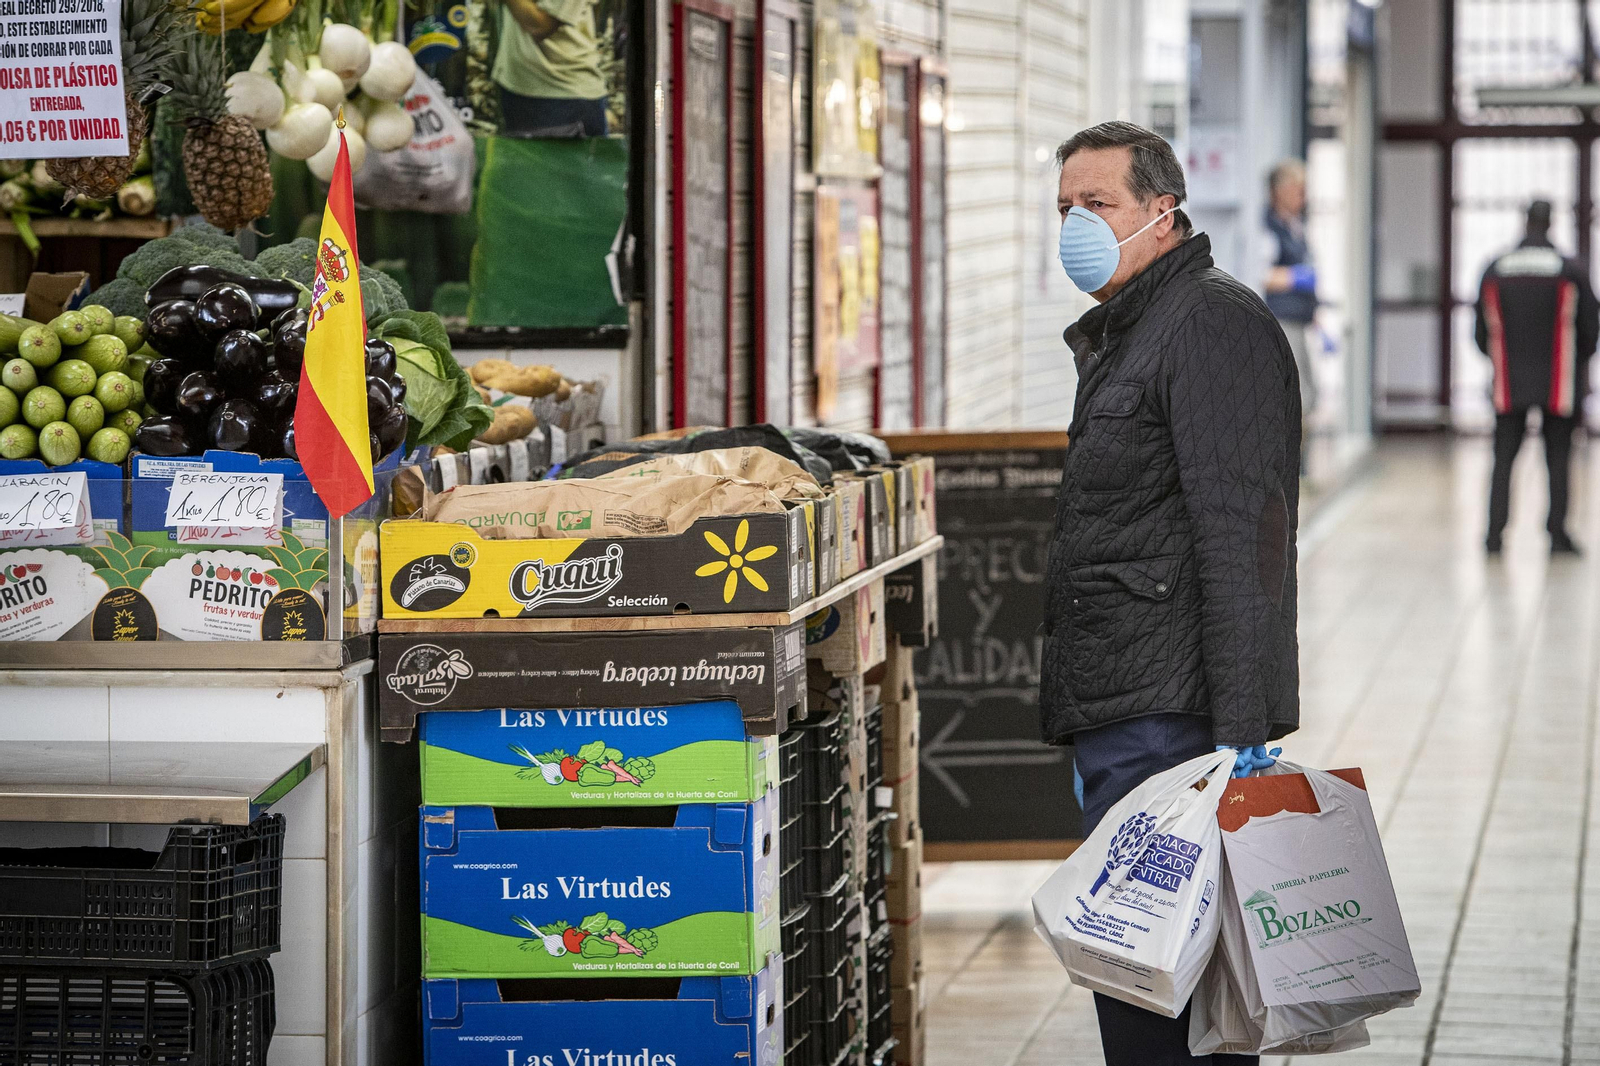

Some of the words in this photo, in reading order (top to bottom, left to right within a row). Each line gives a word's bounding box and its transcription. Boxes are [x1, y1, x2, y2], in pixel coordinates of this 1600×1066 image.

[18, 0, 56, 15] DECRETO
[59, 0, 105, 13] 293/2018,
[8, 21, 28, 36] ESTE
[30, 18, 107, 36] ESTABLECIMIENTO
[19, 43, 29, 57] DE
[31, 42, 68, 57] COBRAR
[69, 41, 87, 56] POR
[88, 40, 113, 55] CADA
[0, 67, 32, 90] OLSA
[35, 67, 51, 88] DE
[53, 62, 118, 88] PLÁSTICO
[30, 96, 85, 111] ENTREGADA,
[26, 120, 37, 142] €
[39, 119, 67, 141] POR
[69, 118, 124, 140] UNIDAD.
[0, 477, 71, 487] LABACIN
[180, 474, 269, 484] BERENJENA
[256, 508, 270, 521] €
[508, 543, 624, 611] Cuqui
[189, 578, 273, 610] PEDRITO
[607, 594, 668, 607] Selección
[13, 611, 18, 620] y
[20, 598, 54, 615] verduras
[203, 603, 228, 615] frutas
[230, 609, 235, 618] y
[602, 660, 677, 687] iceberg
[680, 656, 766, 687] lechuga
[413, 687, 447, 695] Natural
[499, 708, 546, 728] Las
[556, 708, 669, 728] Virtudes
[571, 791, 605, 800] Verduras
[613, 791, 652, 799] Hortalizas
[653, 791, 663, 799] de
[665, 791, 673, 799] la
[676, 791, 702, 799] Huerta
[704, 791, 714, 799] de
[717, 790, 738, 799] Conil
[452, 862, 518, 872] www.coagrico.com
[1271, 878, 1307, 891] LIBRERIA
[1308, 866, 1350, 882] PAPELERIA
[501, 877, 548, 900] Las
[556, 876, 671, 900] Virtudes
[1254, 899, 1361, 940] BOZANO
[572, 962, 607, 970] Verduras
[615, 962, 654, 970] Hortalizas
[656, 962, 665, 970] de
[668, 962, 675, 970] la
[678, 962, 704, 970] Huerta
[706, 962, 716, 970] de
[718, 961, 740, 970] Conil
[458, 1034, 523, 1042] www.coagrico.com
[506, 1049, 553, 1066] Las
[561, 1048, 676, 1066] Virtudes
